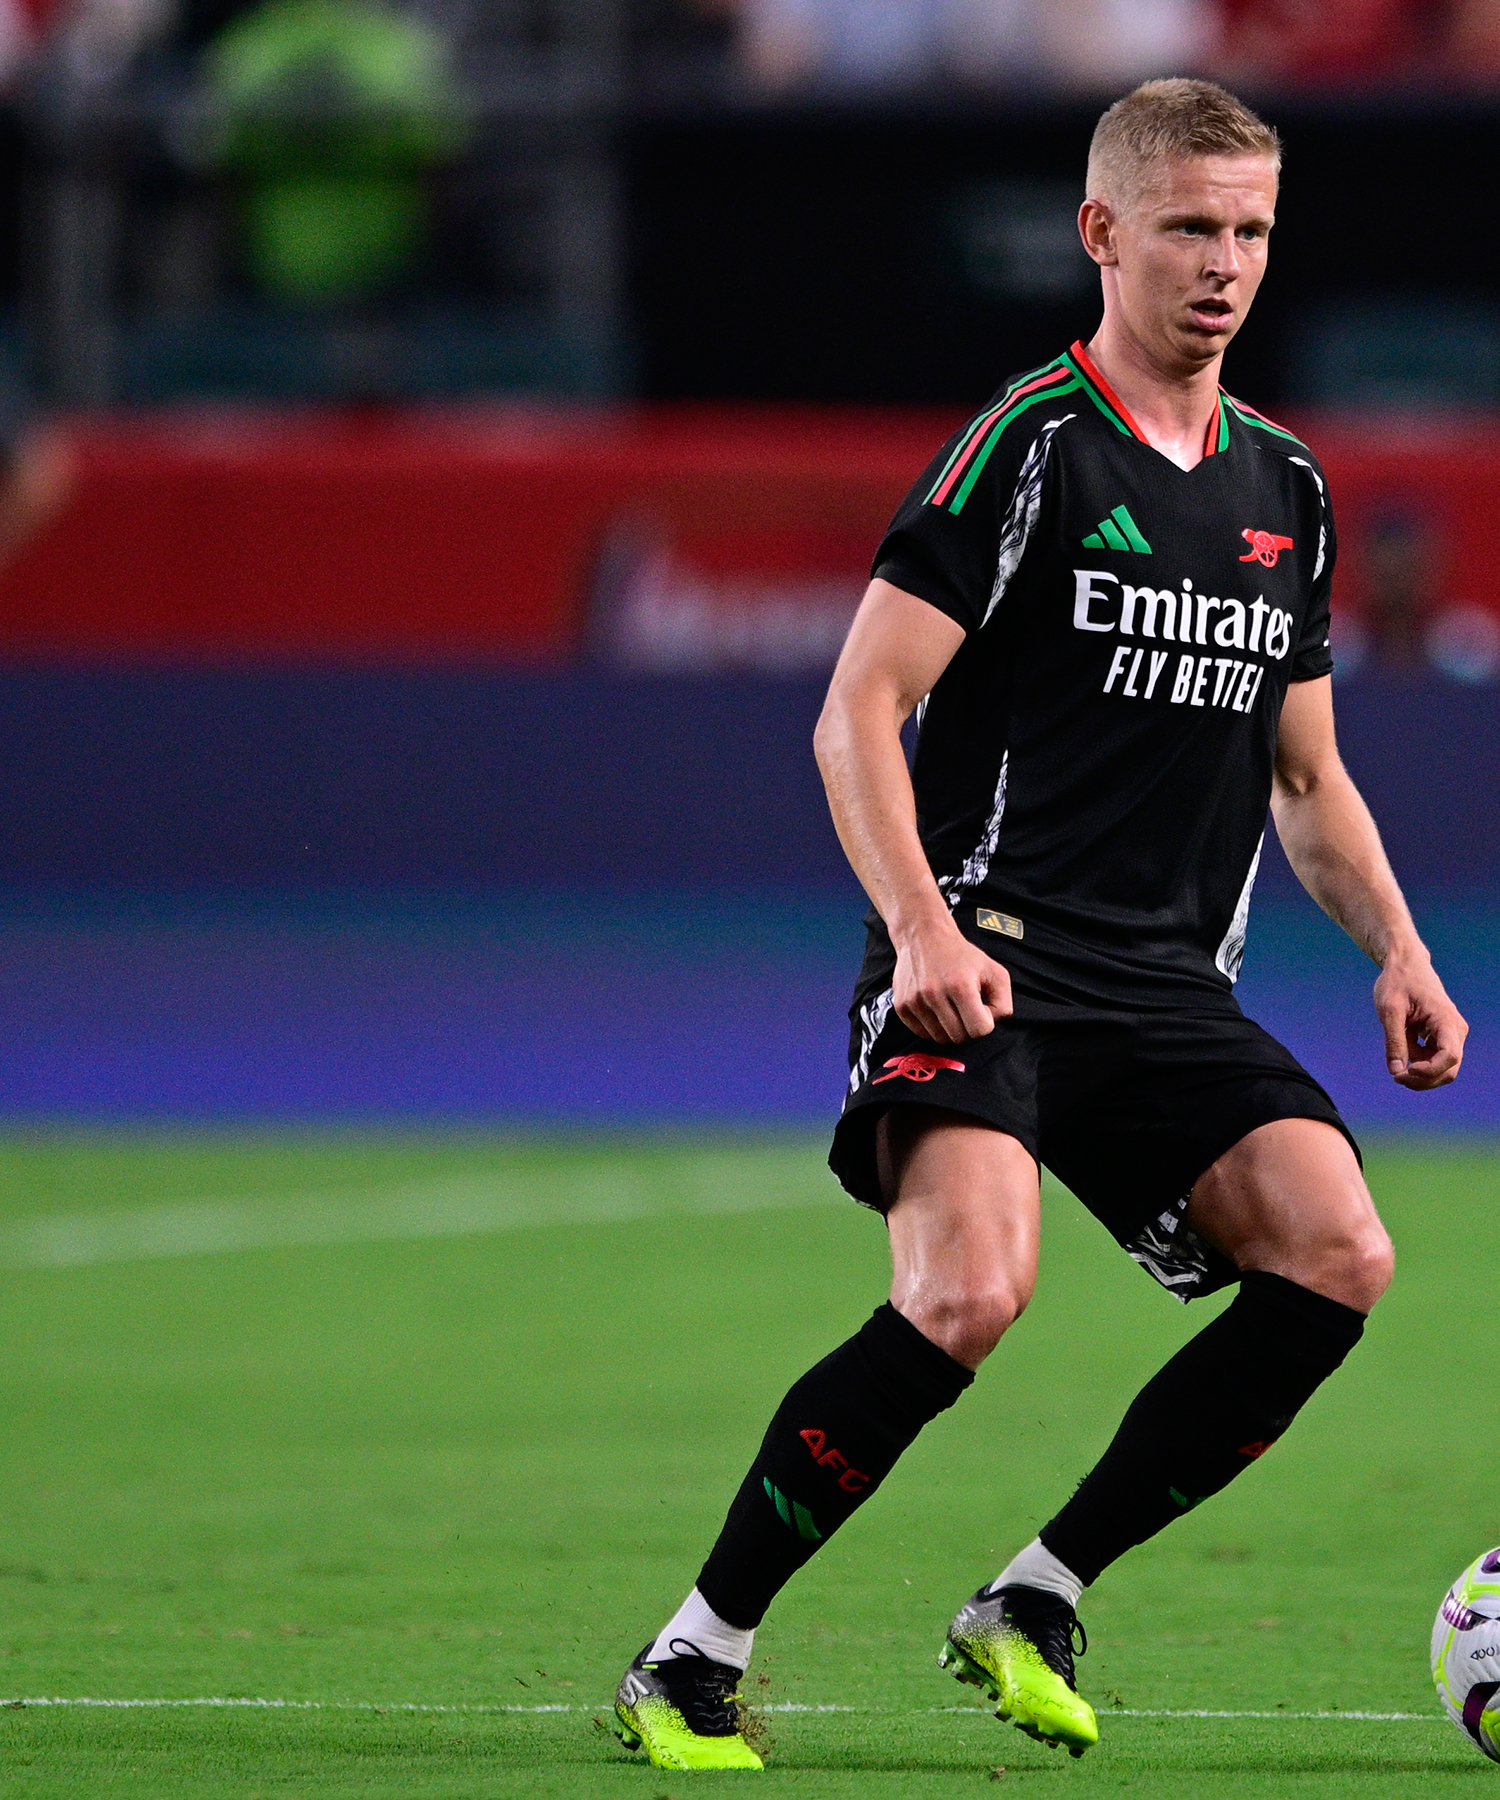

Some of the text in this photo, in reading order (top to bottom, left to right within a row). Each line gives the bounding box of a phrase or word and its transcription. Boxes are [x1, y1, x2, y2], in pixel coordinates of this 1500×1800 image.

[1073, 569, 1293, 660] Emirates
[1102, 645, 1168, 700] FLY
[800, 1428, 870, 1492] AFC
